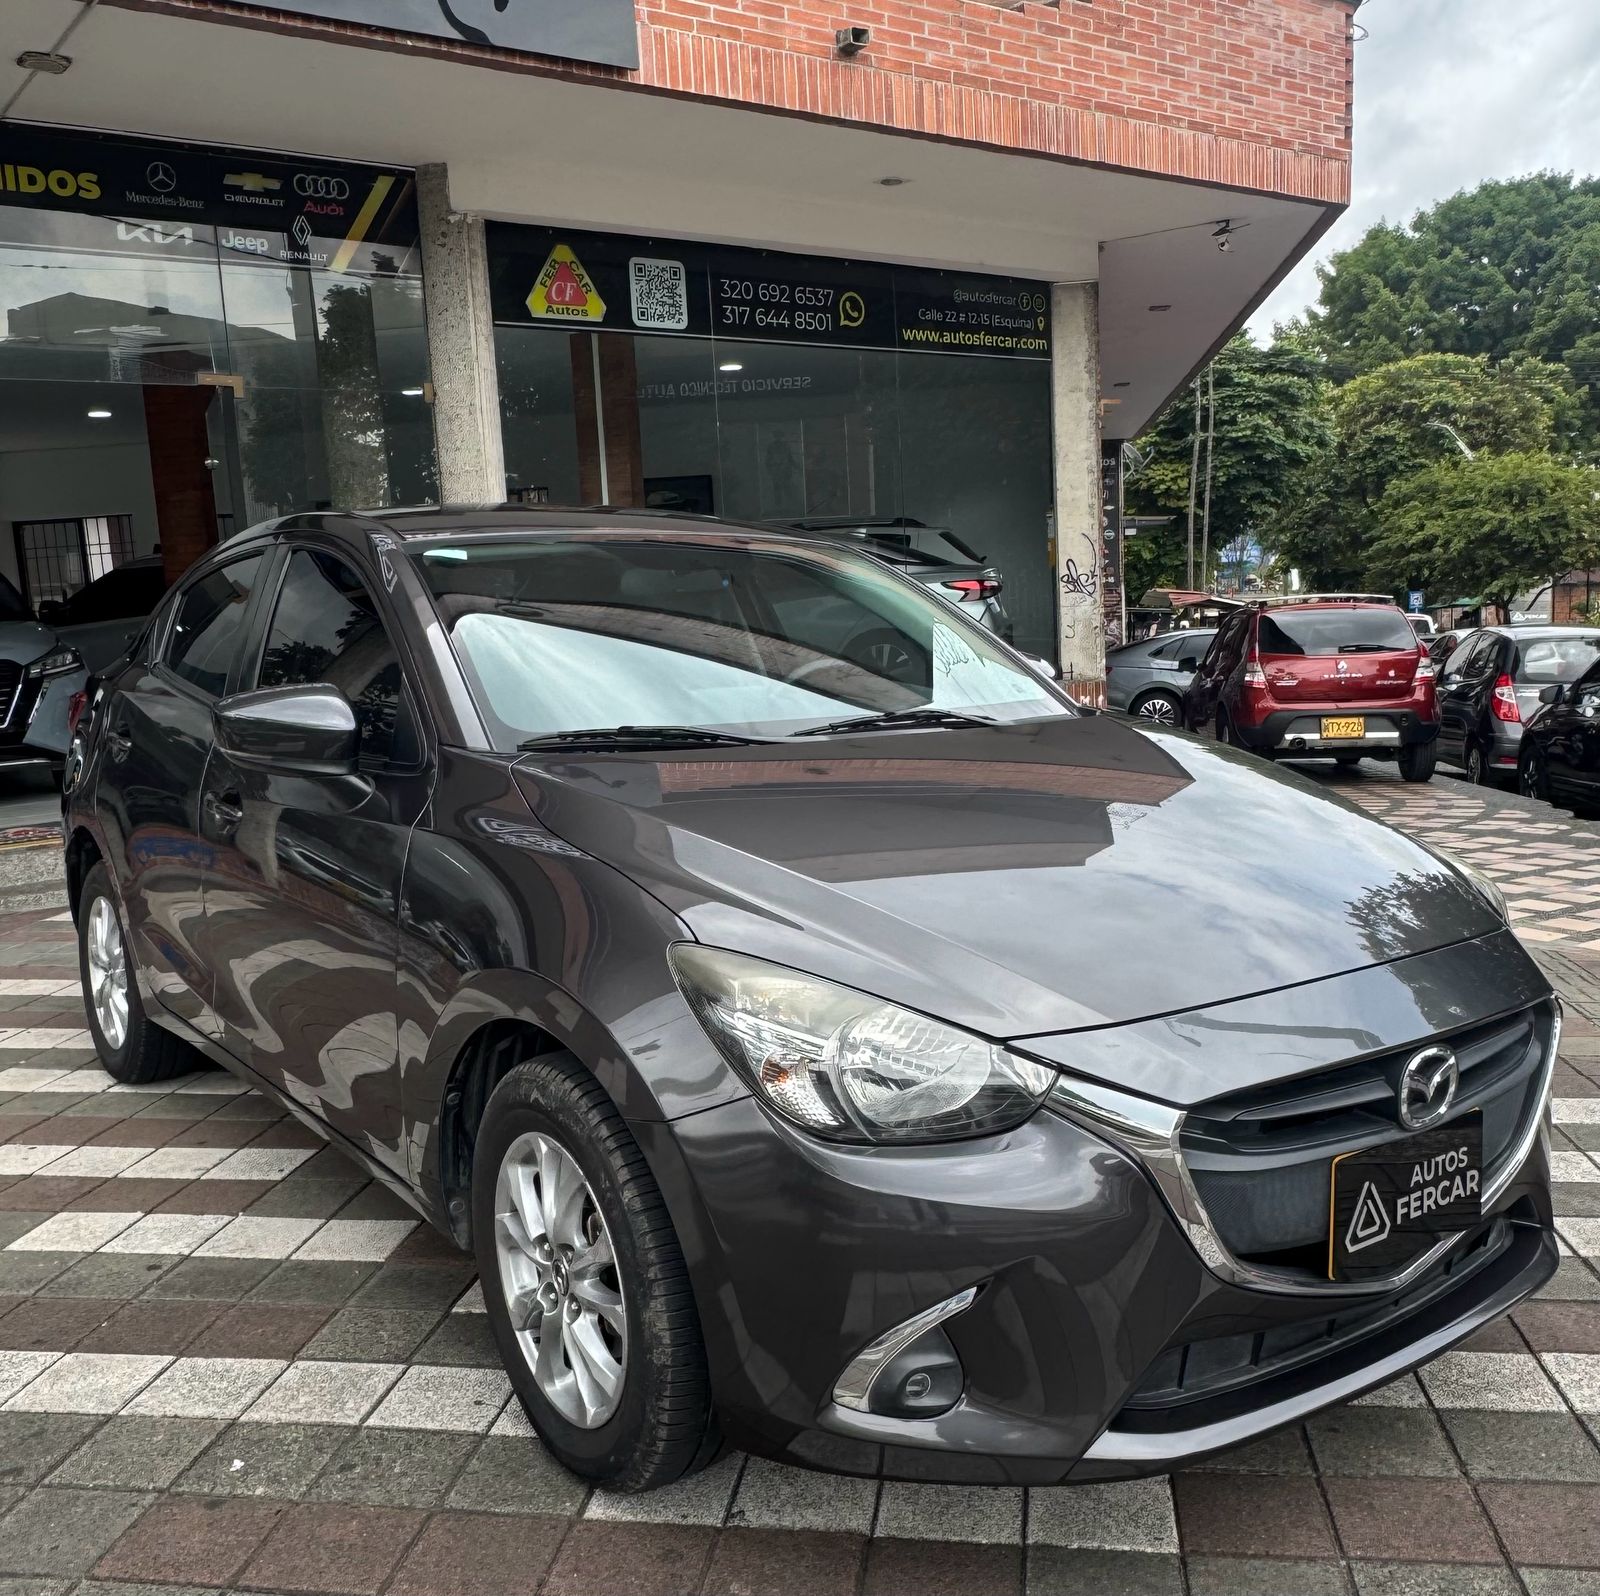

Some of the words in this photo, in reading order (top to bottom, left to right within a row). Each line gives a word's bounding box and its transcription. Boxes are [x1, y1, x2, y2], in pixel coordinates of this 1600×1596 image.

[0, 163, 101, 200] IDOS
[125, 191, 205, 209] Mercedes-Benz
[224, 193, 286, 207] CHEVROLET
[304, 201, 344, 216] Audi
[116, 222, 193, 246] KIA
[222, 230, 269, 254] Jeep
[280, 249, 329, 262] RENAULT
[551, 281, 577, 302] CF
[720, 279, 753, 300] 320
[758, 283, 791, 303] 692
[795, 286, 834, 307] 6537
[953, 289, 1016, 306] @autosfercar
[545, 305, 589, 317] Autos
[722, 305, 750, 325] 317
[755, 308, 790, 328] 644
[794, 311, 832, 331] 8501
[918, 308, 943, 321] Calle
[945, 311, 957, 323] 22
[902, 328, 1048, 350] www.autosfercar.com
